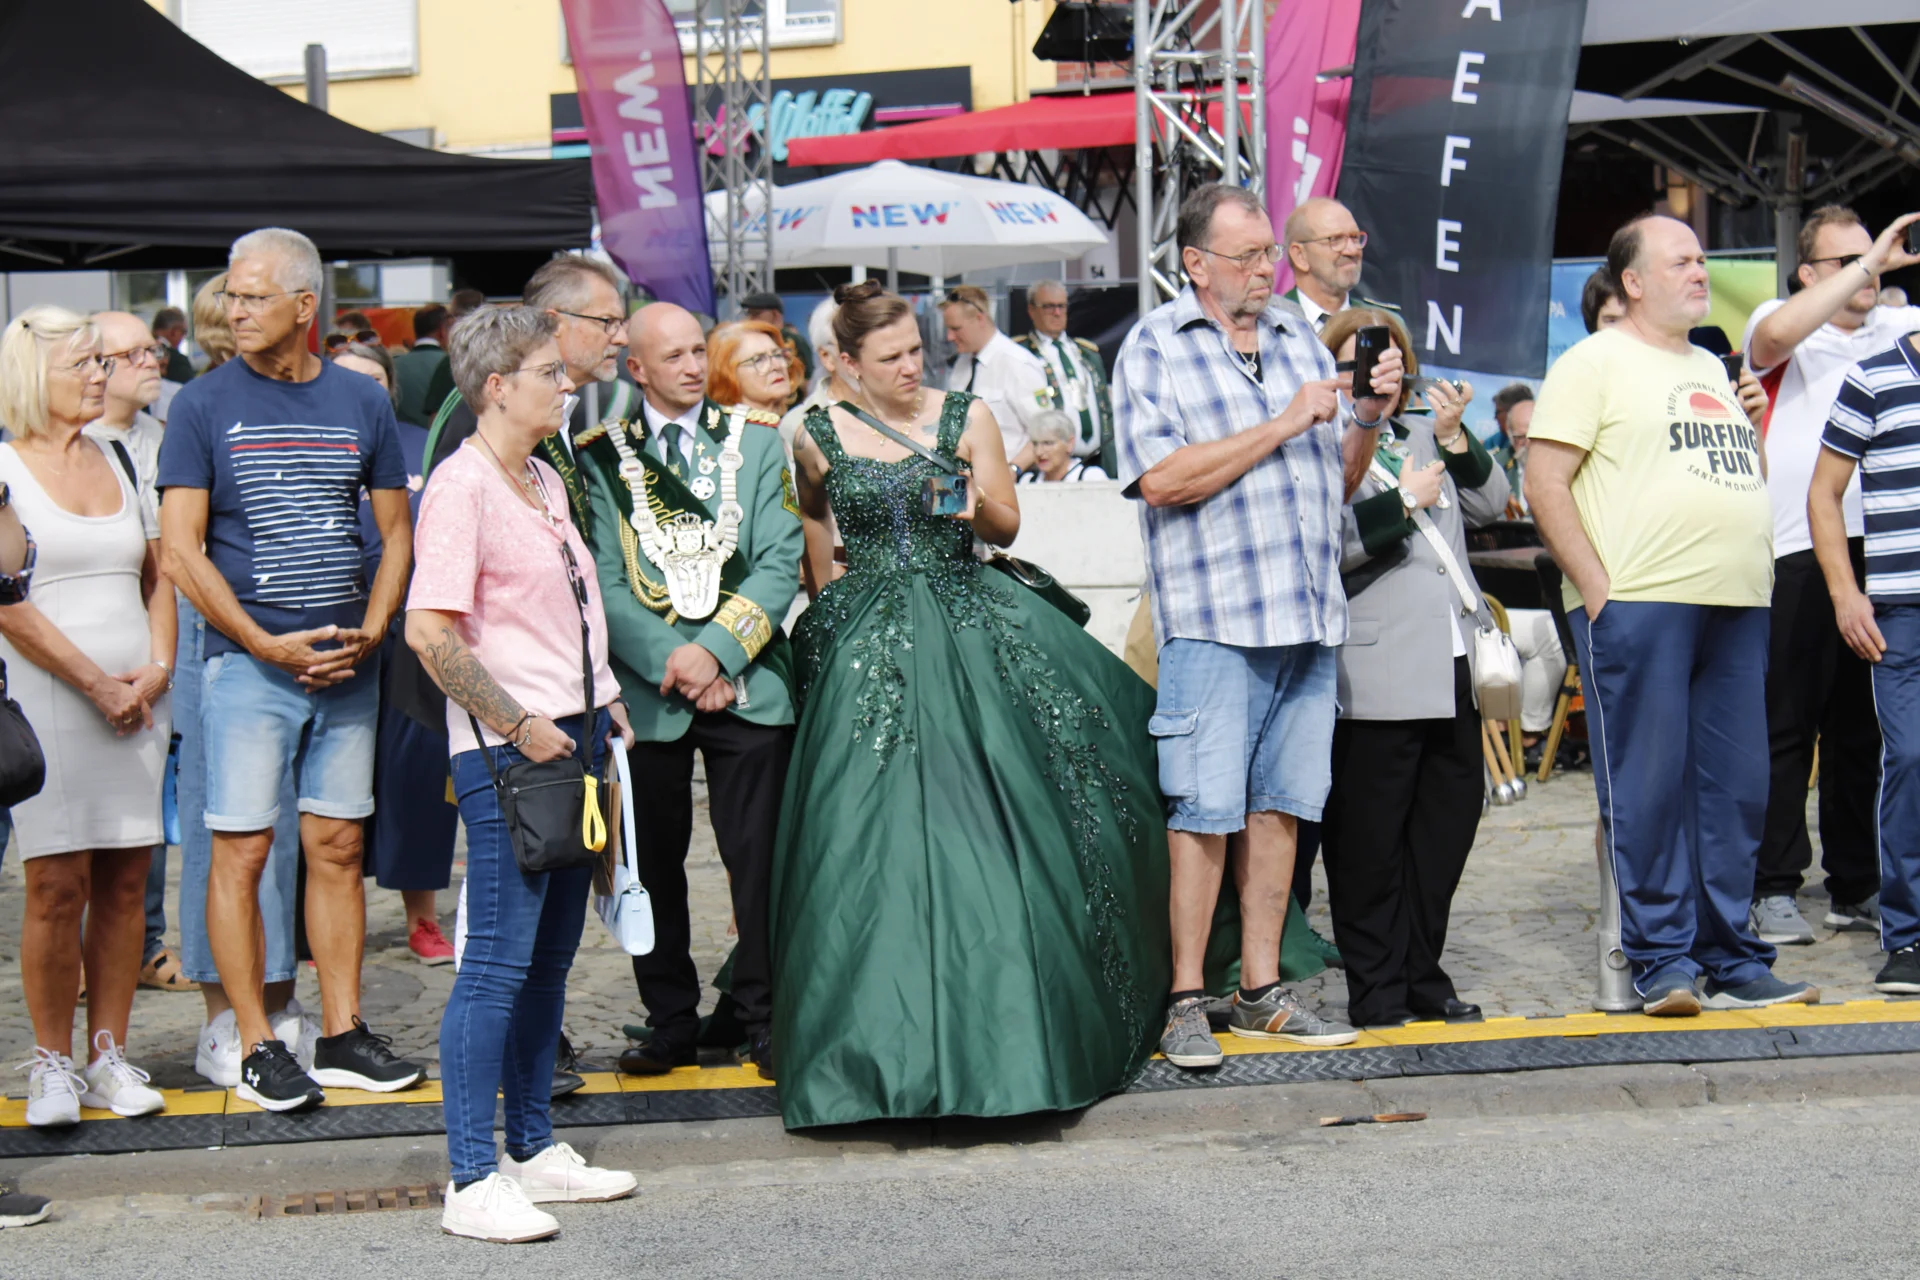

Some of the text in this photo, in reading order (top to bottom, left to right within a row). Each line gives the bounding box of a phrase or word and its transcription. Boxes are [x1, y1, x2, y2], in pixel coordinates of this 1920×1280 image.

[850, 201, 951, 229] NEW
[986, 199, 1061, 225] NEW
[1673, 381, 1716, 394] CALIFORNIA
[1669, 423, 1758, 454] SURFING
[1687, 464, 1721, 486] SANTA
[1707, 451, 1754, 476] FUN
